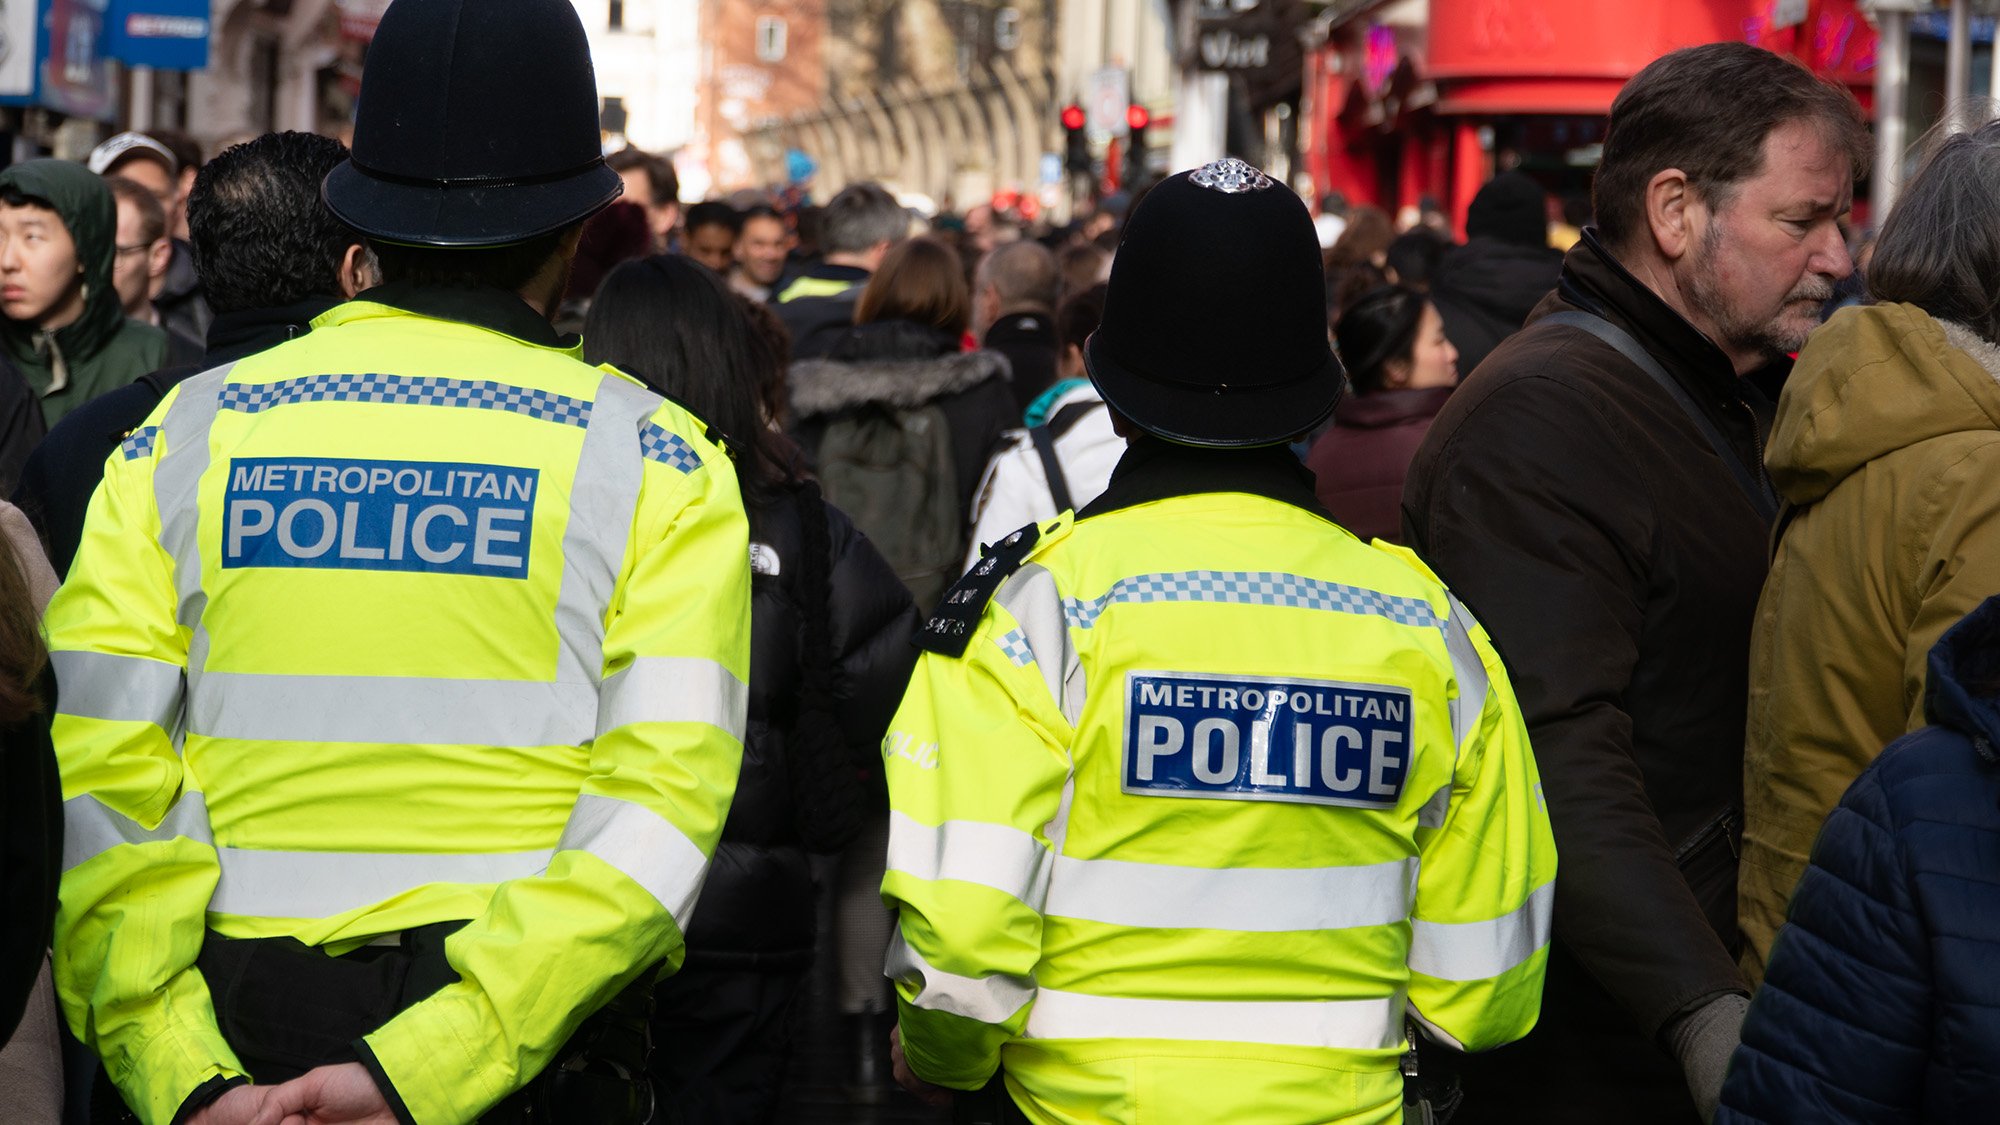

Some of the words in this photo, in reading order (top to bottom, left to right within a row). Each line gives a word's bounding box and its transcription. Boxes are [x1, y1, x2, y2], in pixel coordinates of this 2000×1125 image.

[232, 465, 532, 501] METROPOLITAN
[228, 499, 525, 568] POLICE
[1140, 684, 1404, 722] METROPOLITAN
[1136, 715, 1403, 795] POLICE
